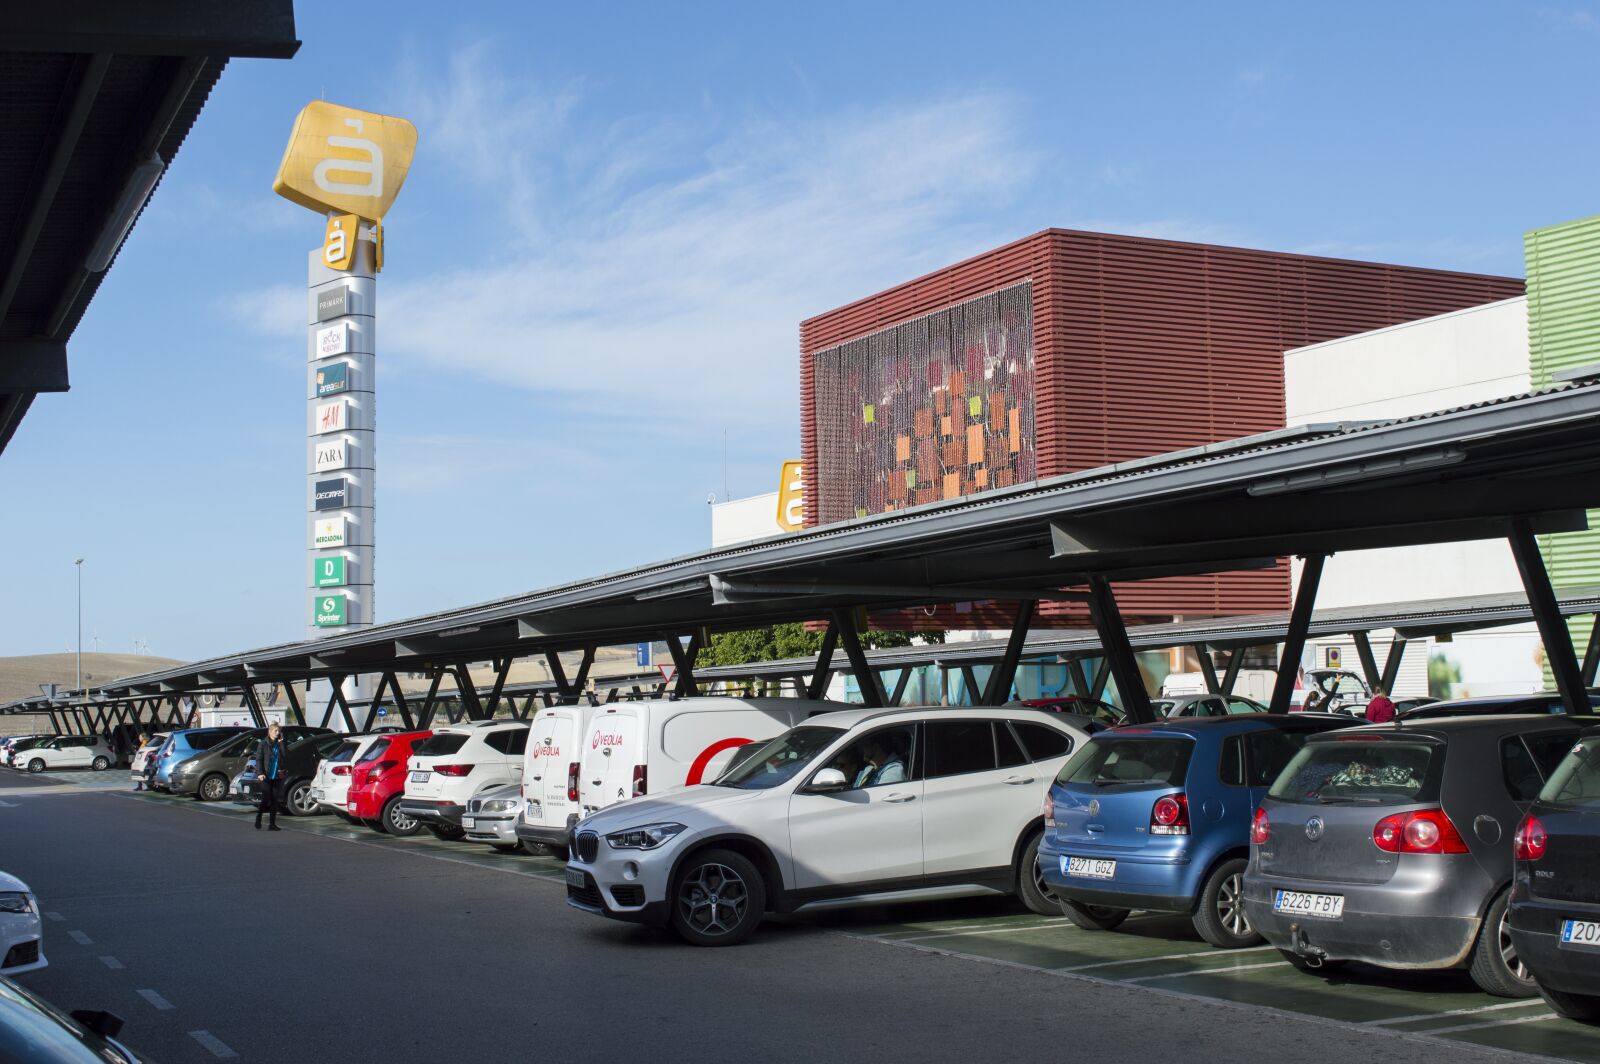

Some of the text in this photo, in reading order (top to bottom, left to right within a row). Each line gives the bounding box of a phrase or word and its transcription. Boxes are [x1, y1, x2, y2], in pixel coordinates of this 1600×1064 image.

[319, 297, 344, 309] PRIMARK
[318, 449, 342, 464] ZARA
[316, 535, 342, 543] MERCADONA
[325, 560, 334, 576] D
[317, 613, 340, 623] Sprinter
[600, 735, 622, 746] VEOLIA
[540, 746, 559, 756] VEOLIA
[1070, 859, 1113, 874] 8271 GGZ
[1282, 893, 1340, 912] 6226 FBY
[1574, 923, 1600, 941] 20
